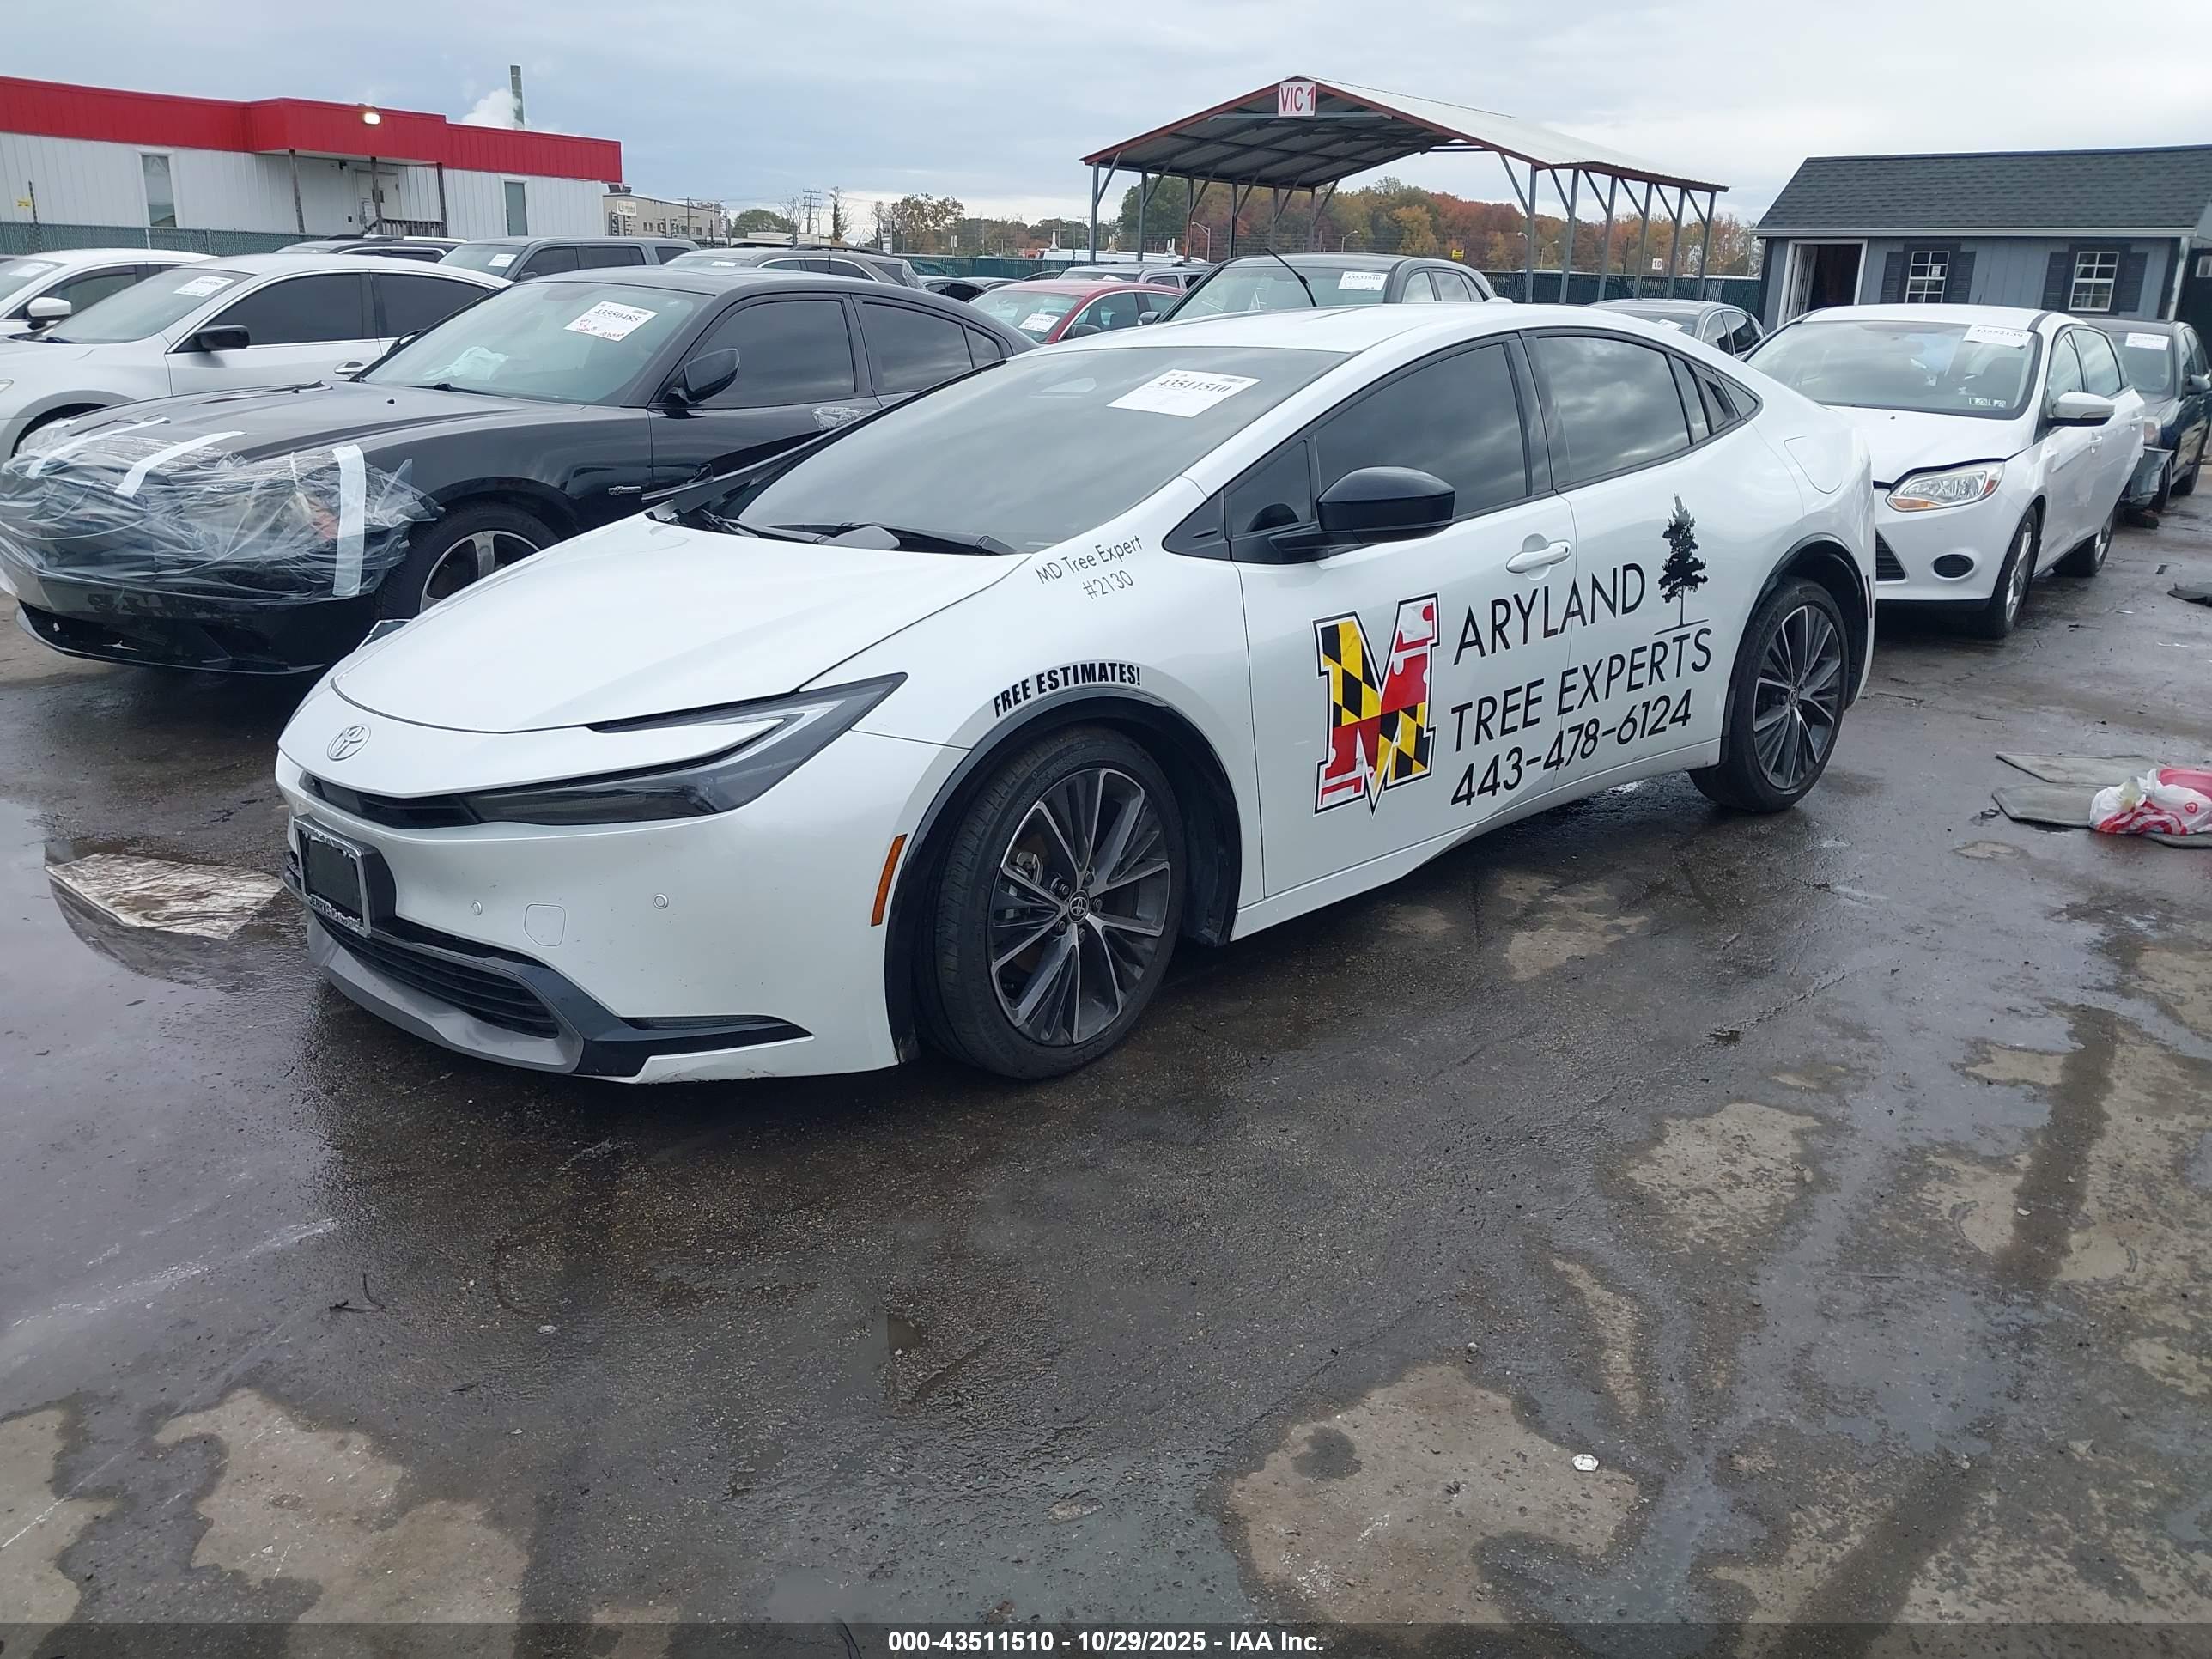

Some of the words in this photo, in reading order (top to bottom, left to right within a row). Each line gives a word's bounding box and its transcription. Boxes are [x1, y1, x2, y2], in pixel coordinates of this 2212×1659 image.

[1280, 86, 1304, 112] VIC
[1307, 86, 1315, 112] 1
[1158, 379, 1232, 392] 43511510
[1034, 562, 1063, 585] MD
[1061, 553, 1097, 574] Tree
[1094, 535, 1144, 563] Expert
[1082, 569, 1134, 600] #2130
[993, 678, 1032, 718] FREE
[1036, 661, 1141, 695] ESTIMATES!
[1450, 678, 1546, 752] TREE
[1556, 627, 1712, 718] EXPERTS
[1450, 688, 1692, 808] 443-478-6124
